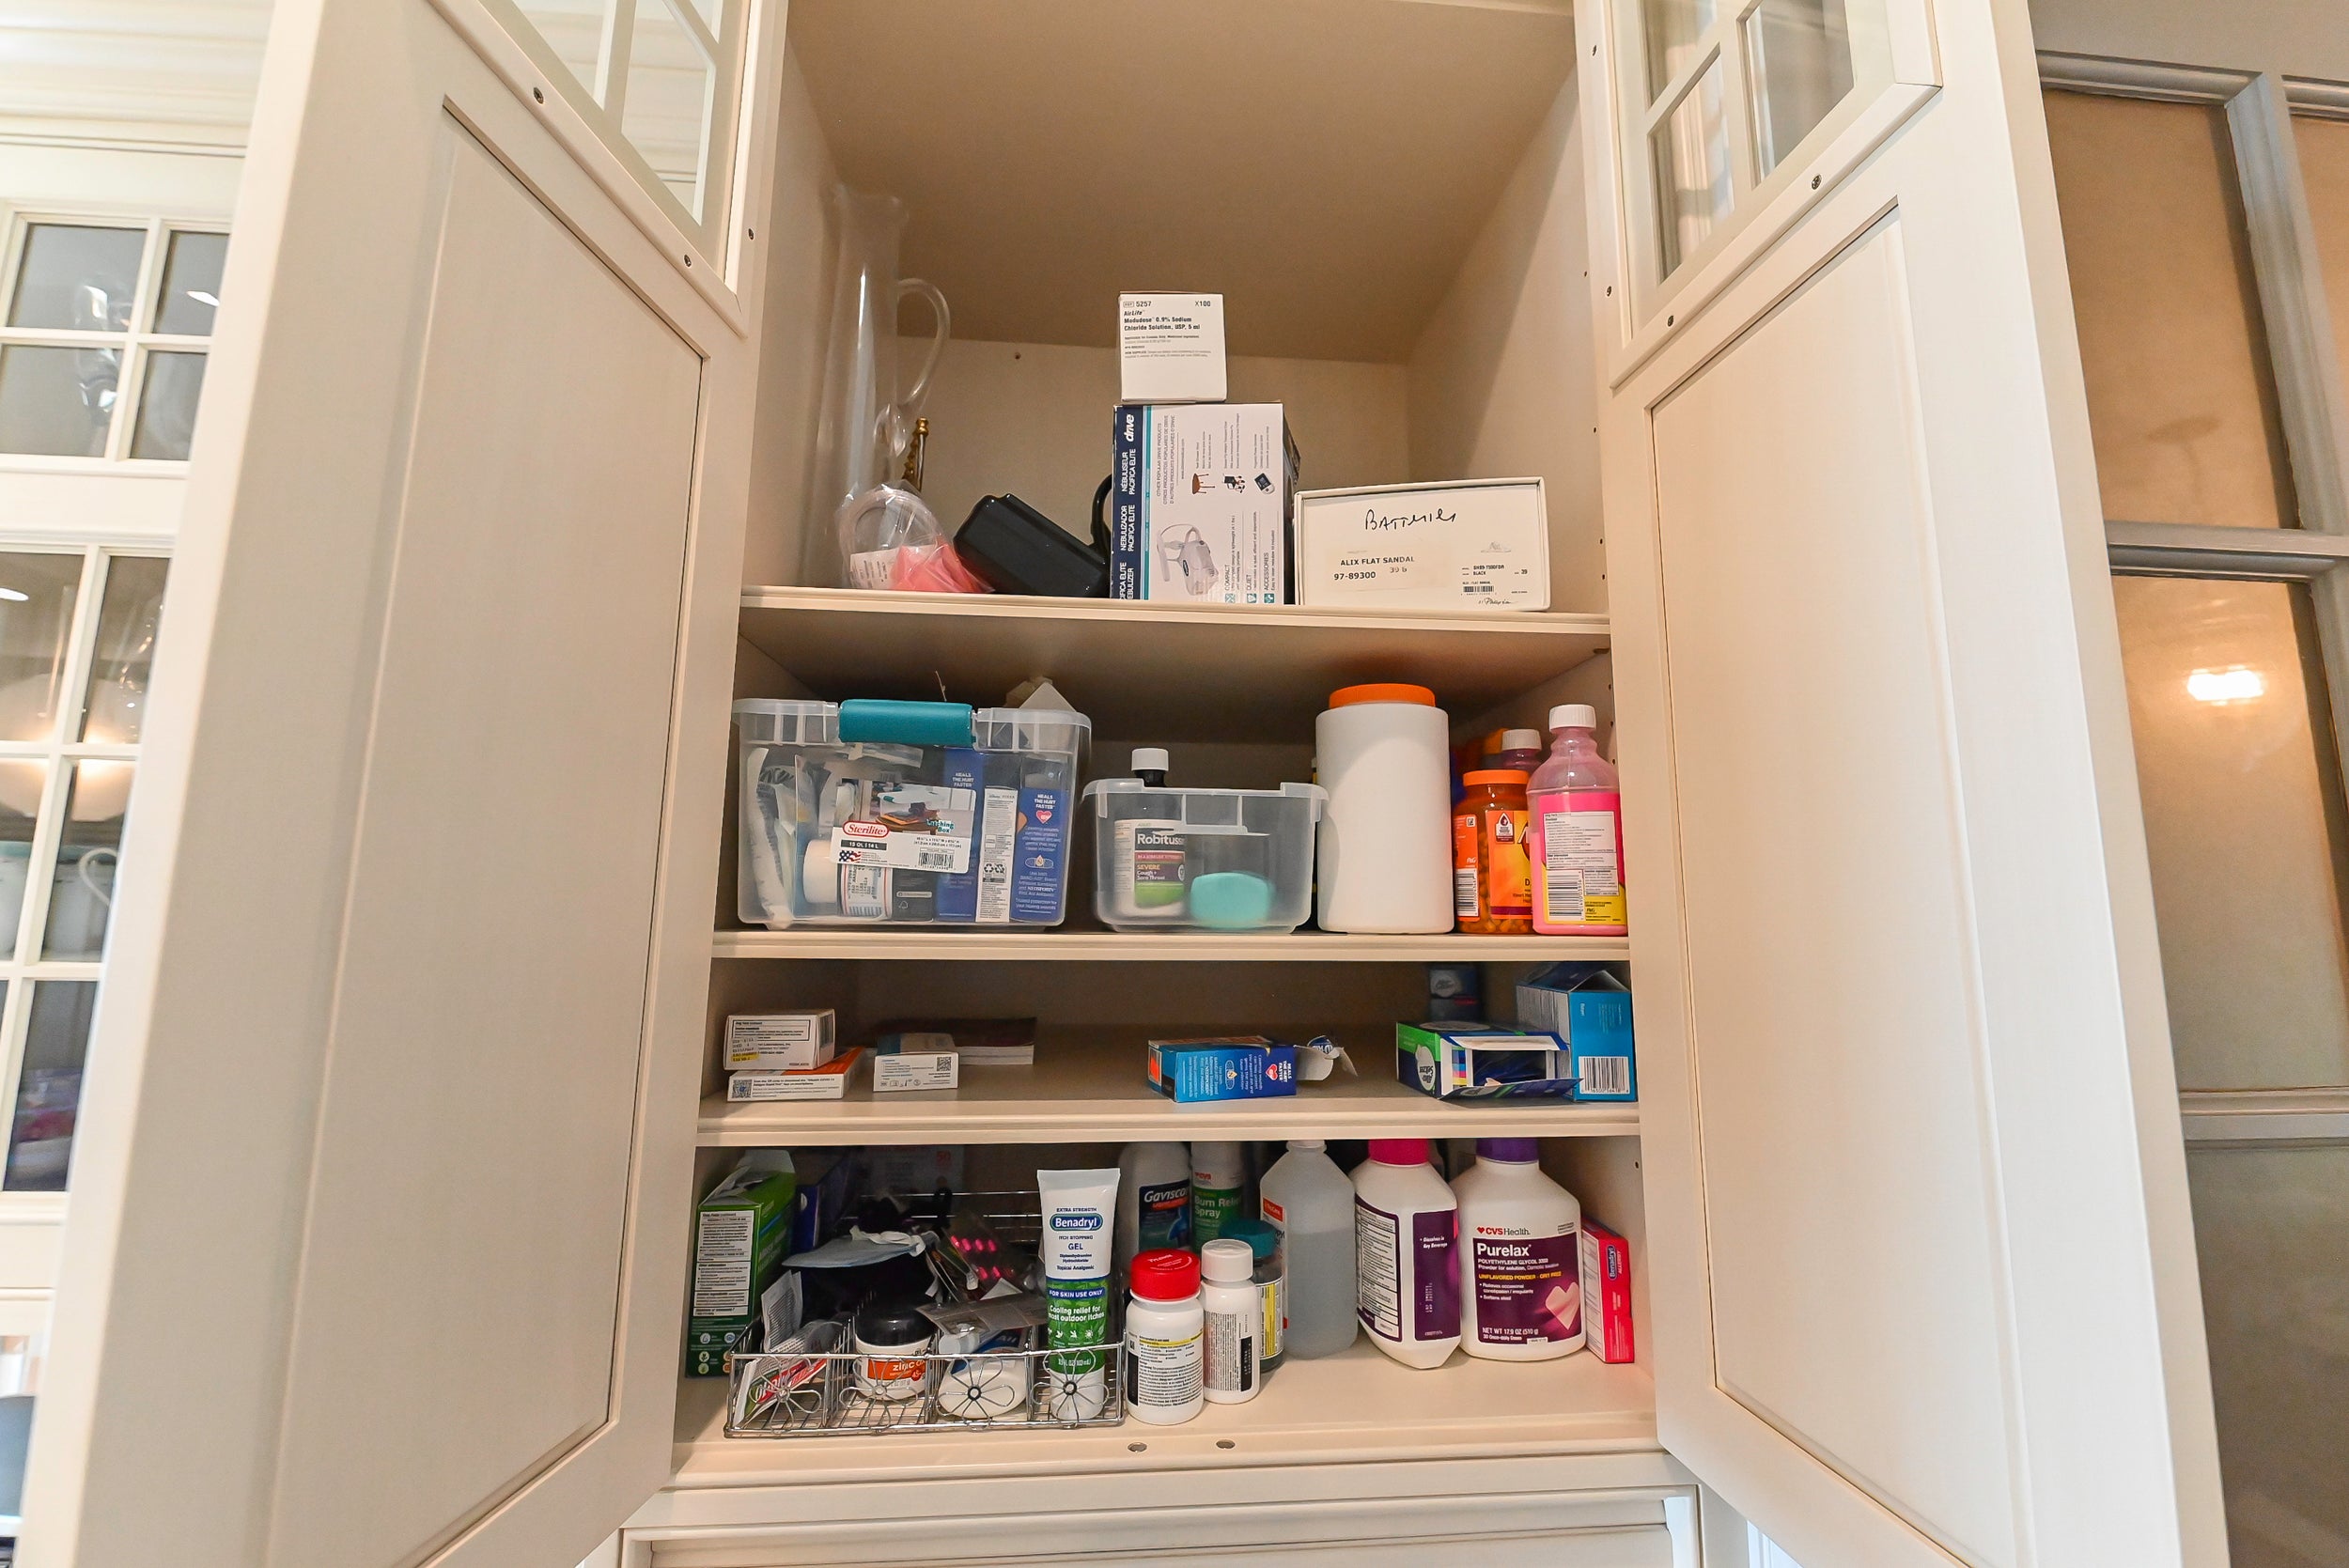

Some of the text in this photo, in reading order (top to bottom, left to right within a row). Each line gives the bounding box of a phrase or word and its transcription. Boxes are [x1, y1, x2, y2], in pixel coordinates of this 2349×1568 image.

[1124, 413, 1135, 442] drive
[1340, 558, 1359, 567] ALIX
[1334, 571, 1377, 581] 97-89300
[1137, 833, 1184, 846] Robituss
[1194, 1195, 1215, 1207] Burn
[1195, 1205, 1221, 1219] Spray
[1055, 1218, 1097, 1230] Benadryl
[1050, 1305, 1072, 1315] Cooling
[1073, 1306, 1090, 1314] relief
[1048, 1312, 1060, 1321] most
[1087, 1312, 1105, 1321] itches
[893, 1362, 915, 1372] zinc
